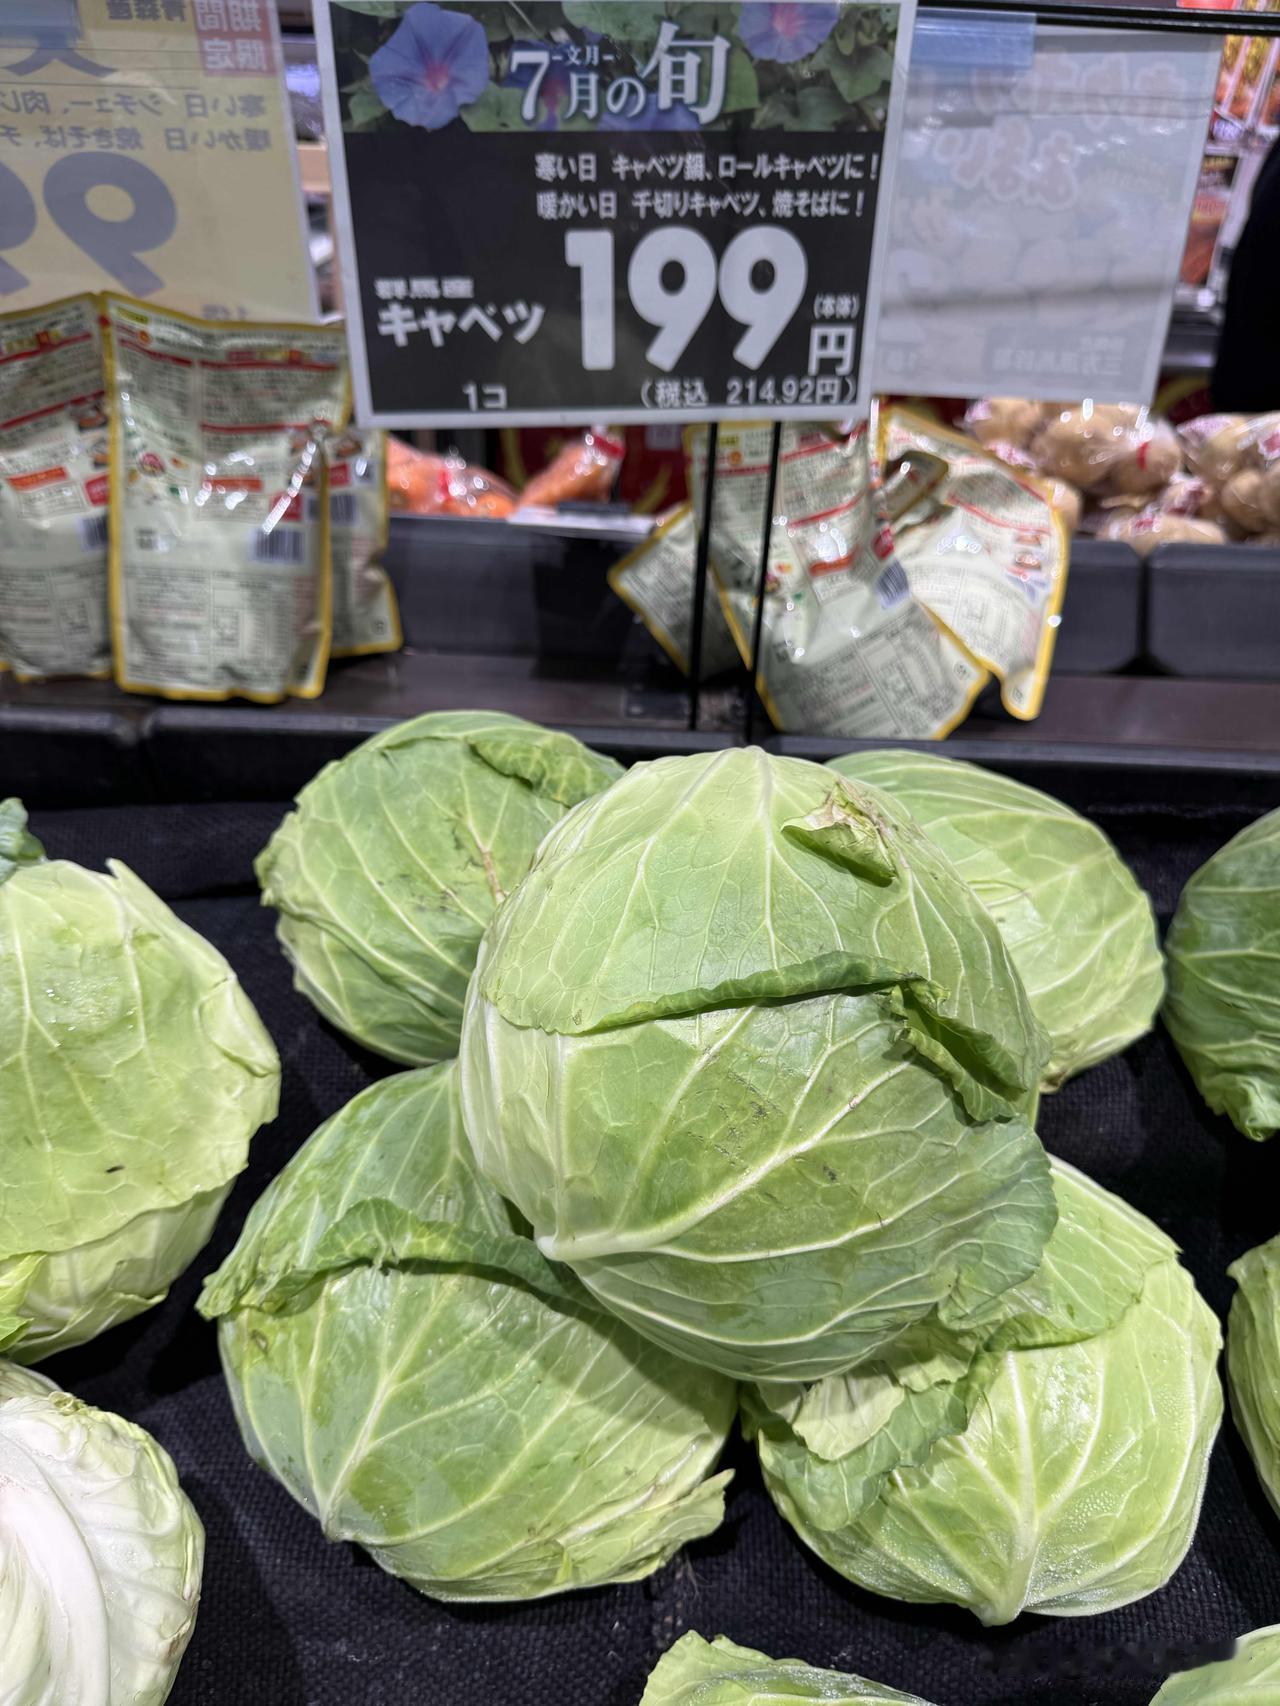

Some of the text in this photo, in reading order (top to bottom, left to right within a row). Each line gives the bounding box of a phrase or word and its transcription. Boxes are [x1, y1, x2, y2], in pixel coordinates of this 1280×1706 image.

[509, 20, 732, 125] 7月の旬
[534, 153, 597, 182] 寒い日
[536, 190, 617, 219] 暖かい日
[564, 226, 809, 372] 199
[377, 301, 546, 348] キャベツ
[807, 322, 857, 377] 円
[462, 381, 508, 412] 1コ
